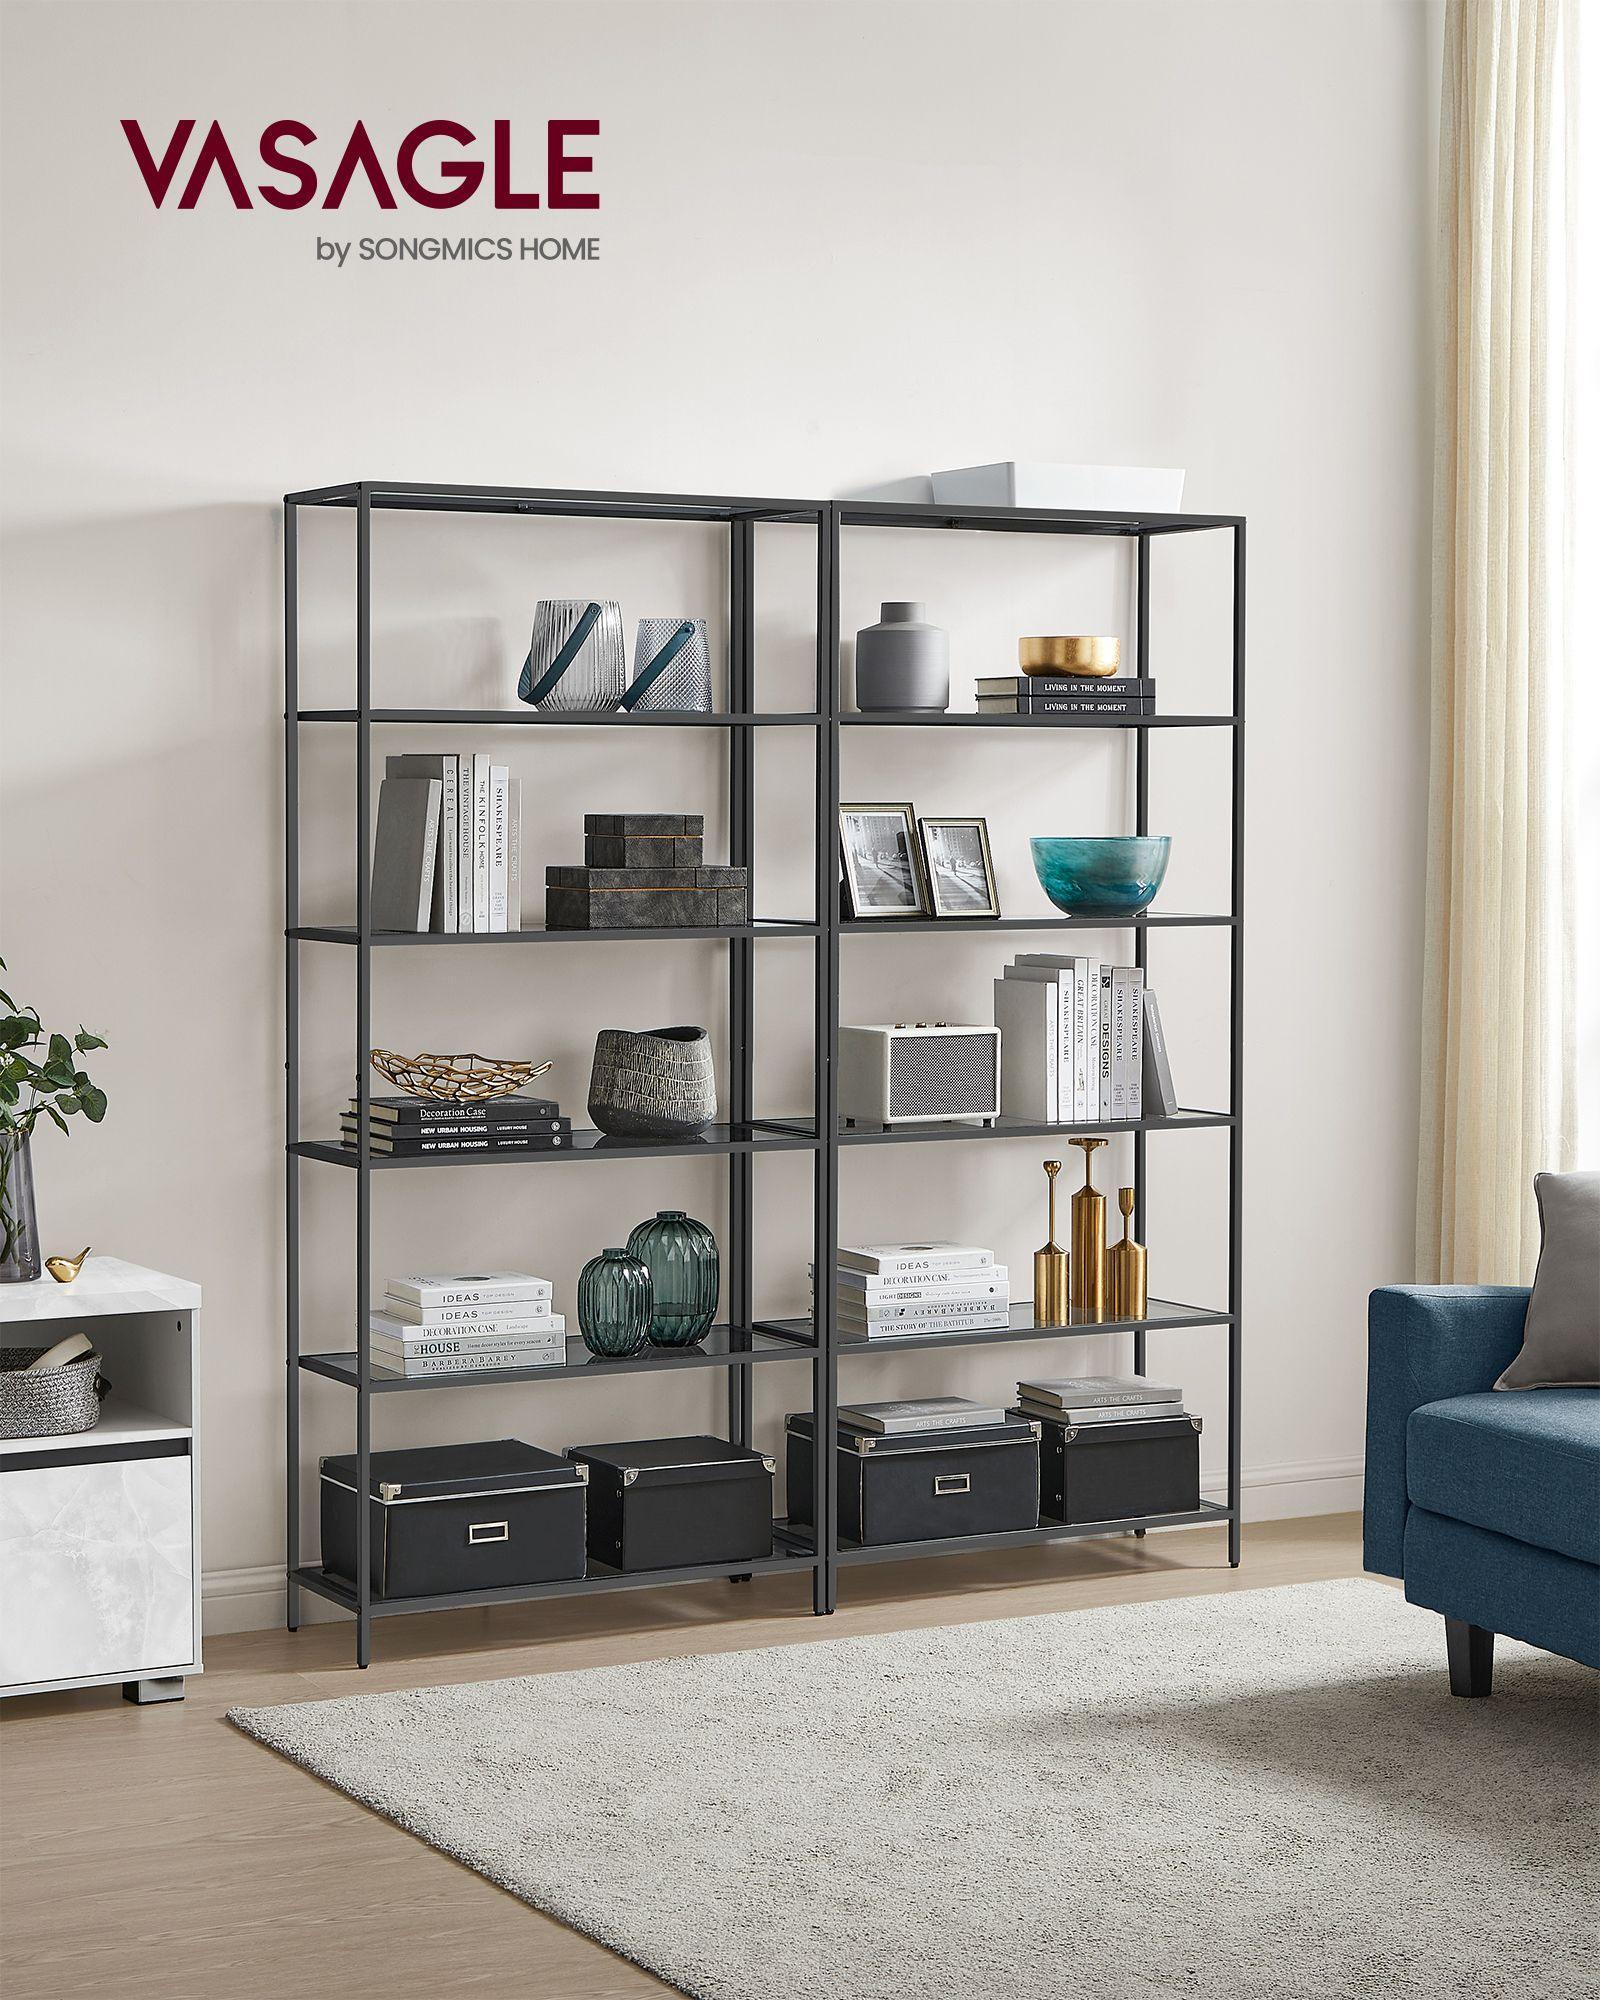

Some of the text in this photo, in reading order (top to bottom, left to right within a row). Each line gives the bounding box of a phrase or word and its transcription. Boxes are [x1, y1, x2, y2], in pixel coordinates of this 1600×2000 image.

[1044, 683, 1068, 692] LIVING
[1070, 684, 1079, 692] IN
[1080, 684, 1095, 692] THE
[1044, 703, 1068, 711] LIVING
[1070, 703, 1079, 712] IN
[1080, 704, 1095, 712] THE
[1090, 974, 1098, 1027] DECORATION
[420, 1108, 486, 1118] Decoration Case
[896, 1261, 929, 1270] IDEAS
[883, 1275, 931, 1285] DECORATION
[442, 1293, 480, 1303] IDEAS
[950, 1304, 995, 1312] BARBERA
[441, 1310, 478, 1320] IDEAS
[928, 1321, 943, 1329] THE
[423, 1326, 477, 1337] DECORATION
[421, 1342, 460, 1354] HOUSE
[422, 1356, 475, 1368] BARBERA
[479, 1354, 516, 1363] BAREY
[915, 1417, 967, 1428] ARTS THE CRAFTS
